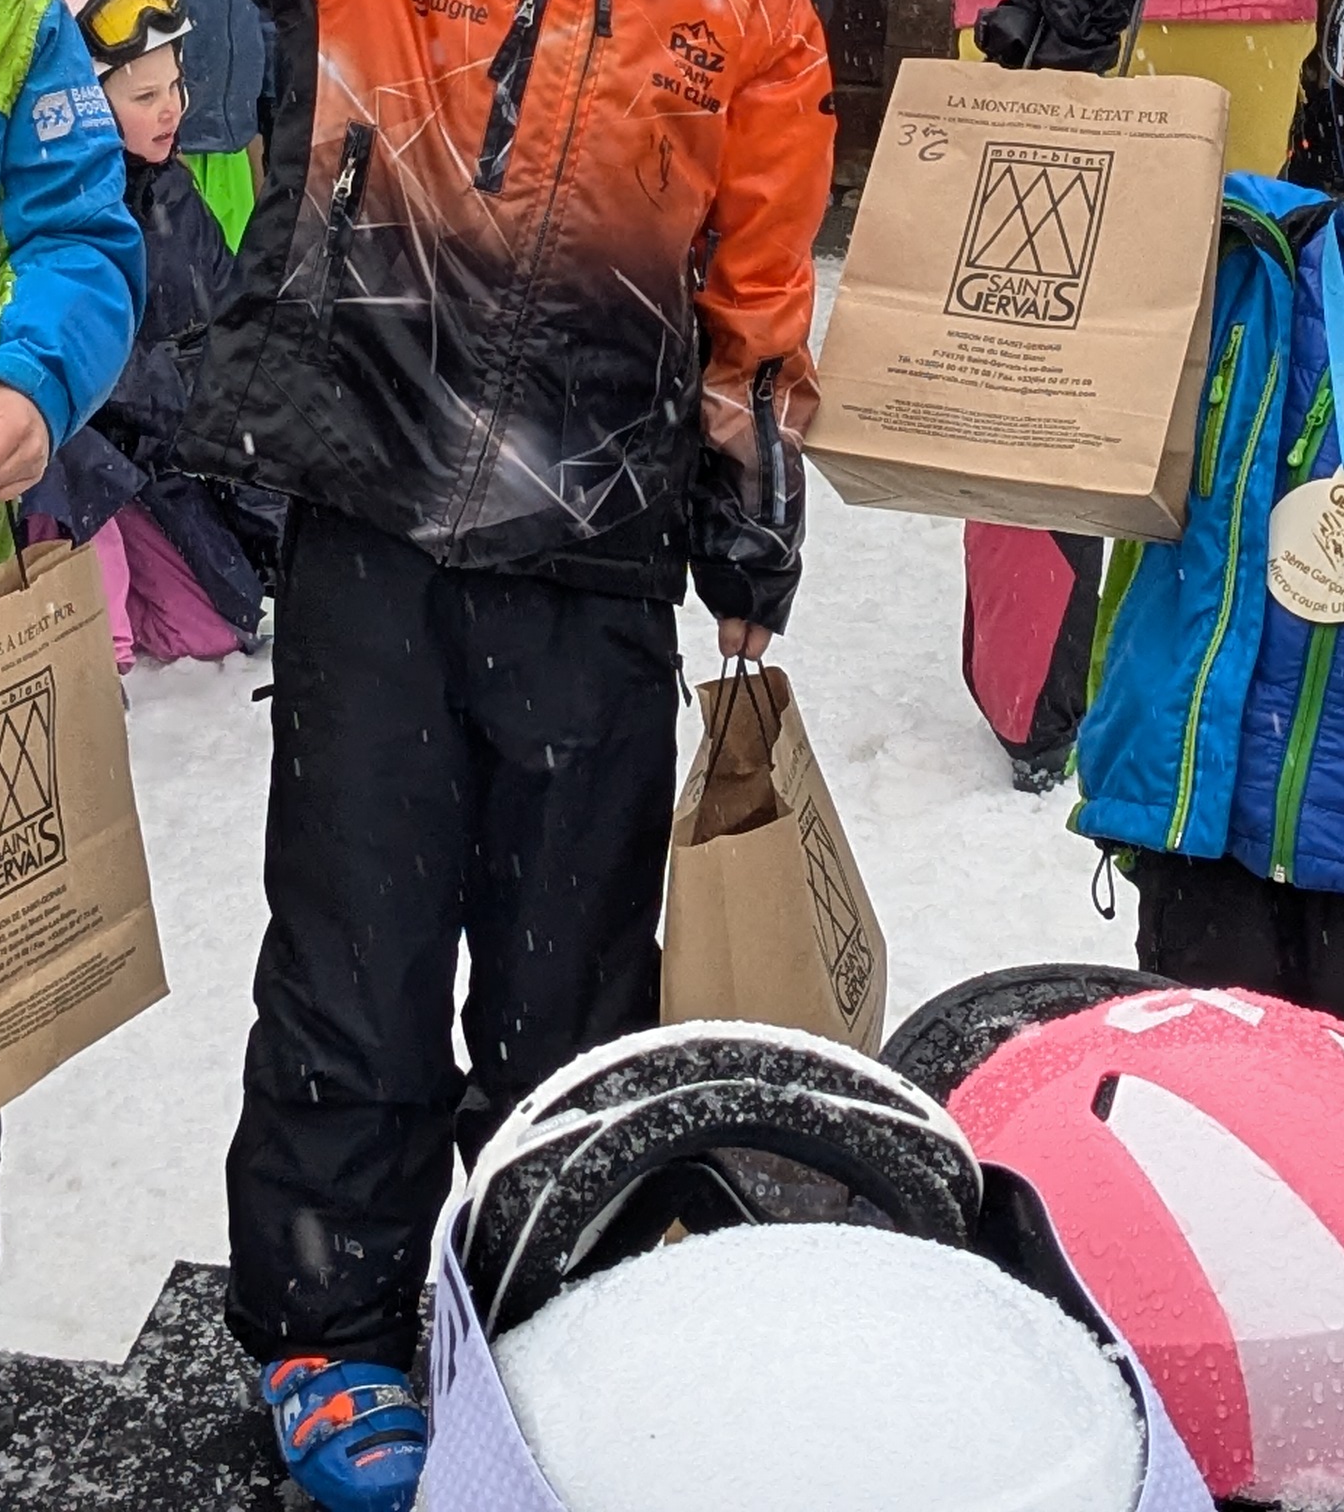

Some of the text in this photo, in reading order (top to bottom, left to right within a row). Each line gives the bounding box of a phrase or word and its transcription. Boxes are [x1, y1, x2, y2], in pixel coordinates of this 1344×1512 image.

[669, 31, 725, 73] Praz
[652, 72, 721, 114] SKI CLUB
[946, 95, 1169, 125] LA MONTAGNE À L'ÉTAT PUR
[990, 147, 1108, 168] mont-blanc
[956, 272, 1080, 322] GERVAIS
[987, 274, 1056, 299] SAINT
[6, 634, 16, 653] À
[54, 602, 76, 626] PUR
